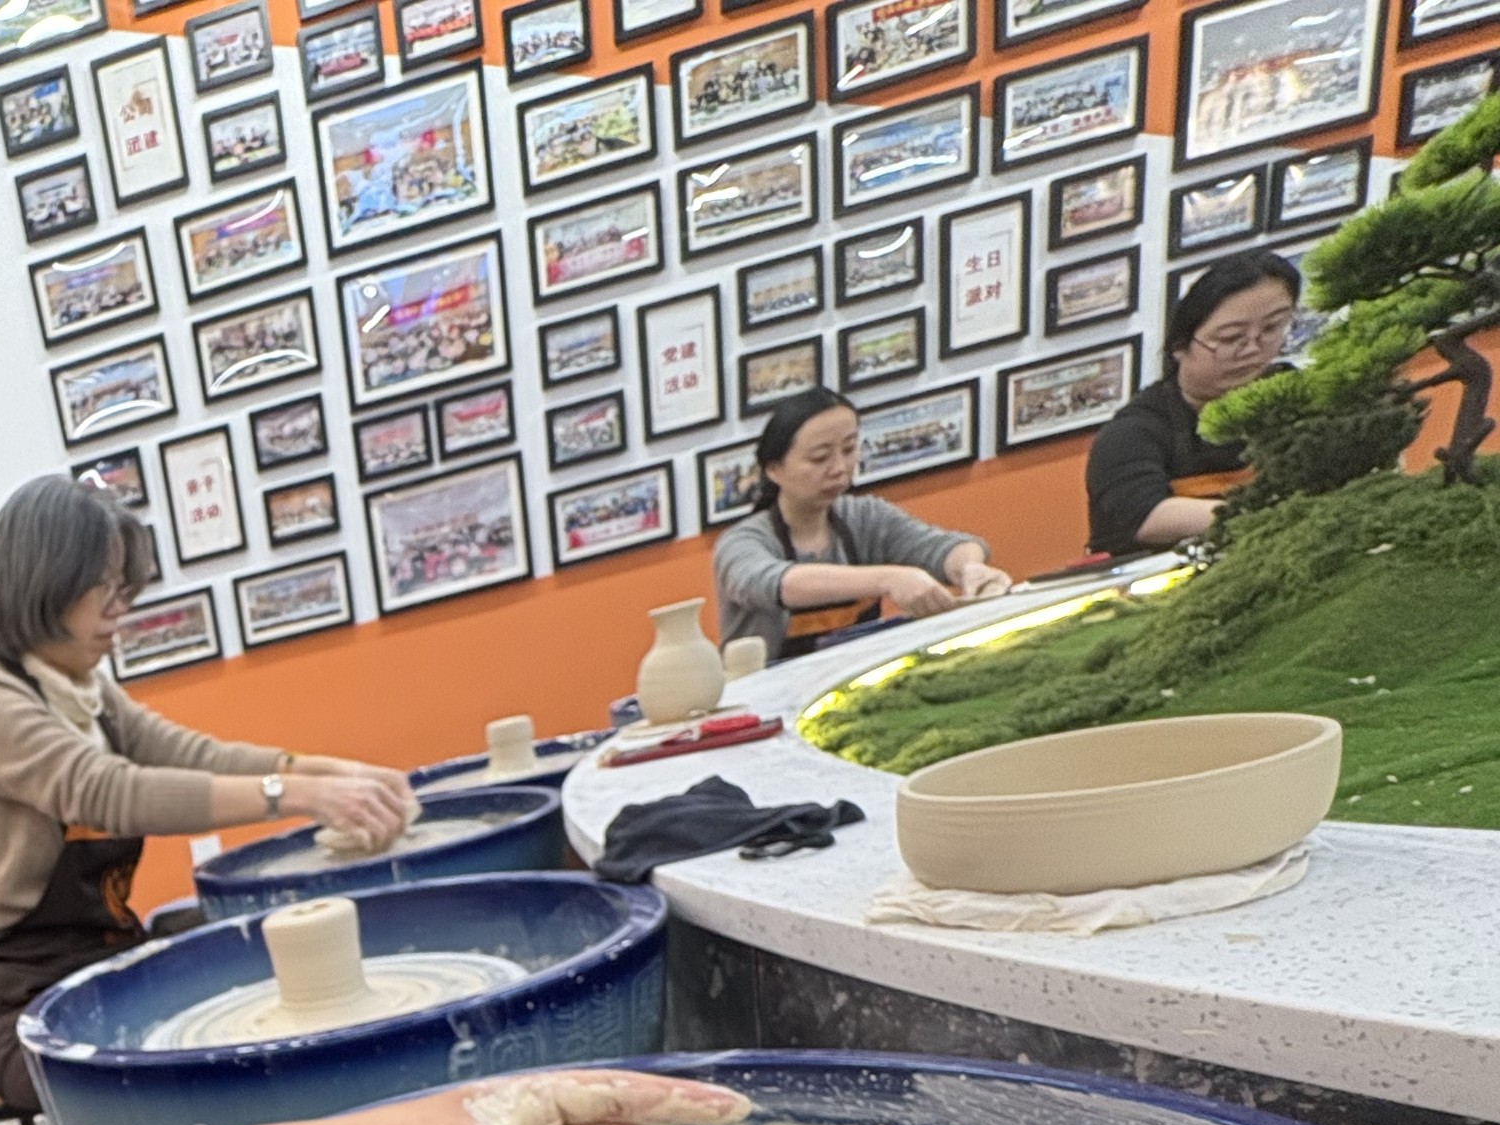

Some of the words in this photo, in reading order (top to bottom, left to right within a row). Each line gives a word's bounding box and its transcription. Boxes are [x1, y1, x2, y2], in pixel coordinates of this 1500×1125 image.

[125, 131, 160, 156] 团建
[965, 250, 1001, 275] 生日
[965, 281, 1001, 307] 派对
[662, 342, 697, 365] 党建
[665, 372, 698, 395] 活动
[191, 504, 220, 524] 活动
